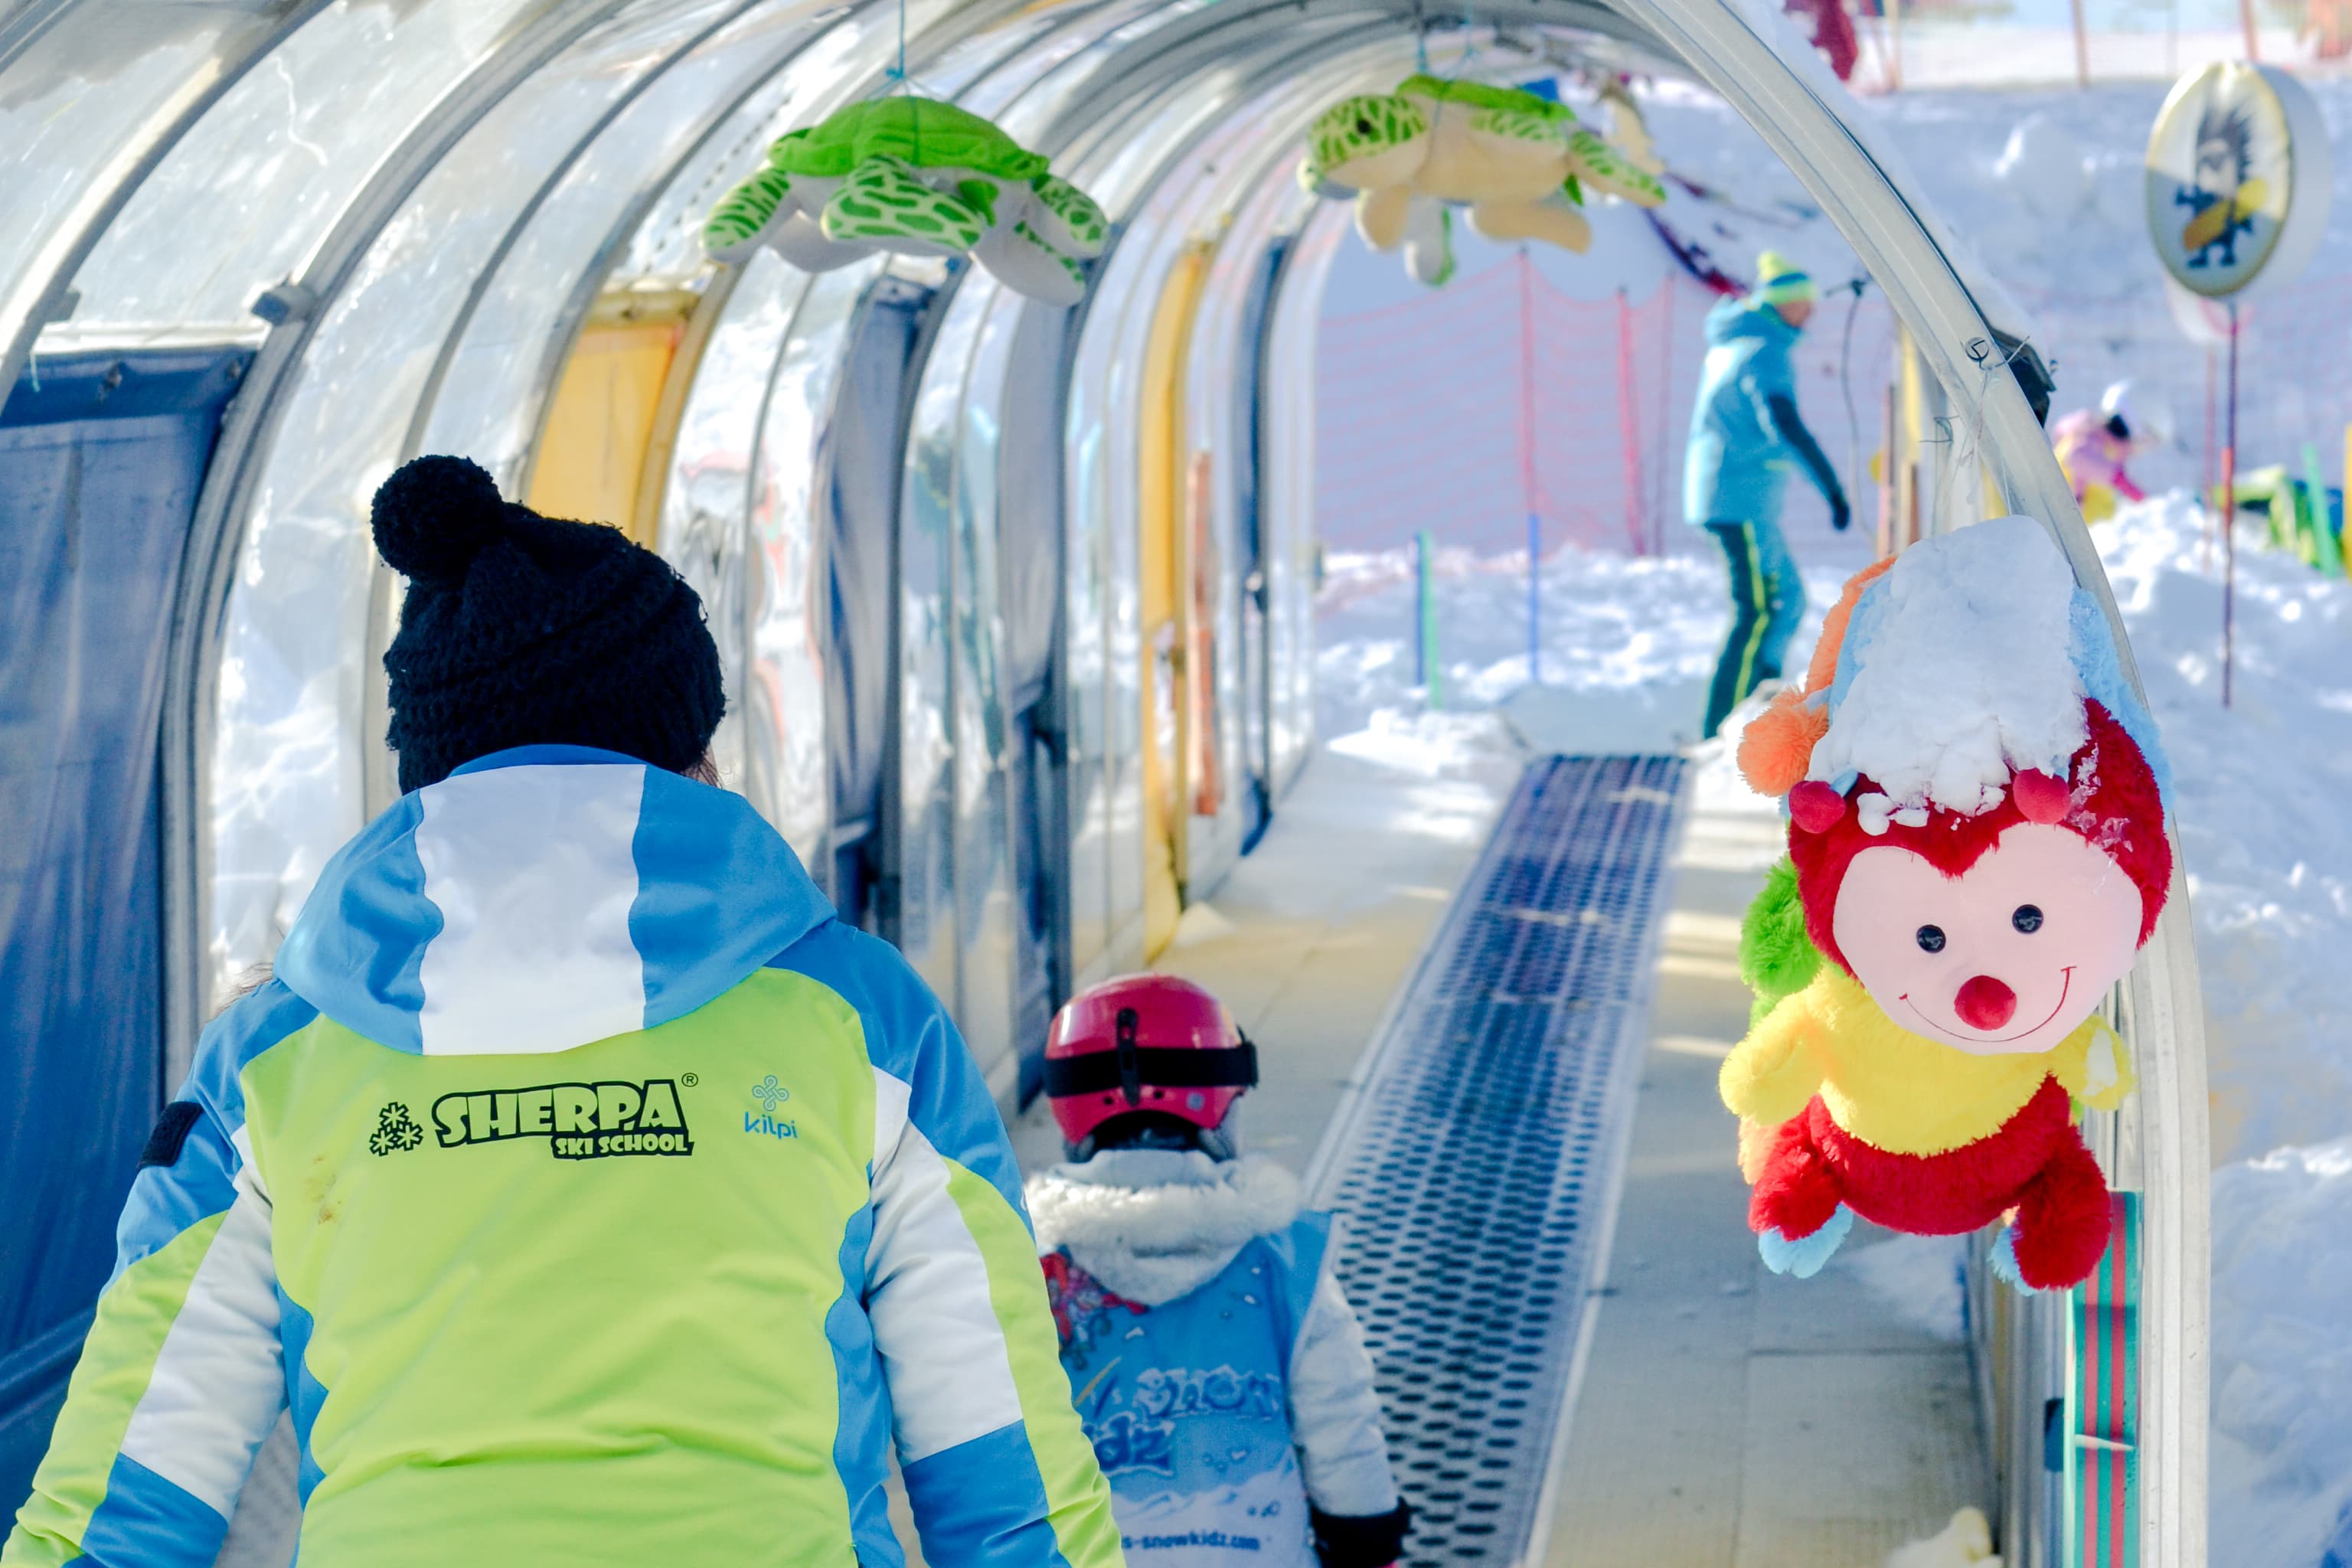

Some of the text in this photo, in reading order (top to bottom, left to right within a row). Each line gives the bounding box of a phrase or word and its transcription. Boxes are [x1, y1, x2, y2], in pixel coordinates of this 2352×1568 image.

[432, 1079, 688, 1148] SHERPA
[744, 1111, 798, 1139] kilpi
[553, 1133, 691, 1157] SKI SCHOOL
